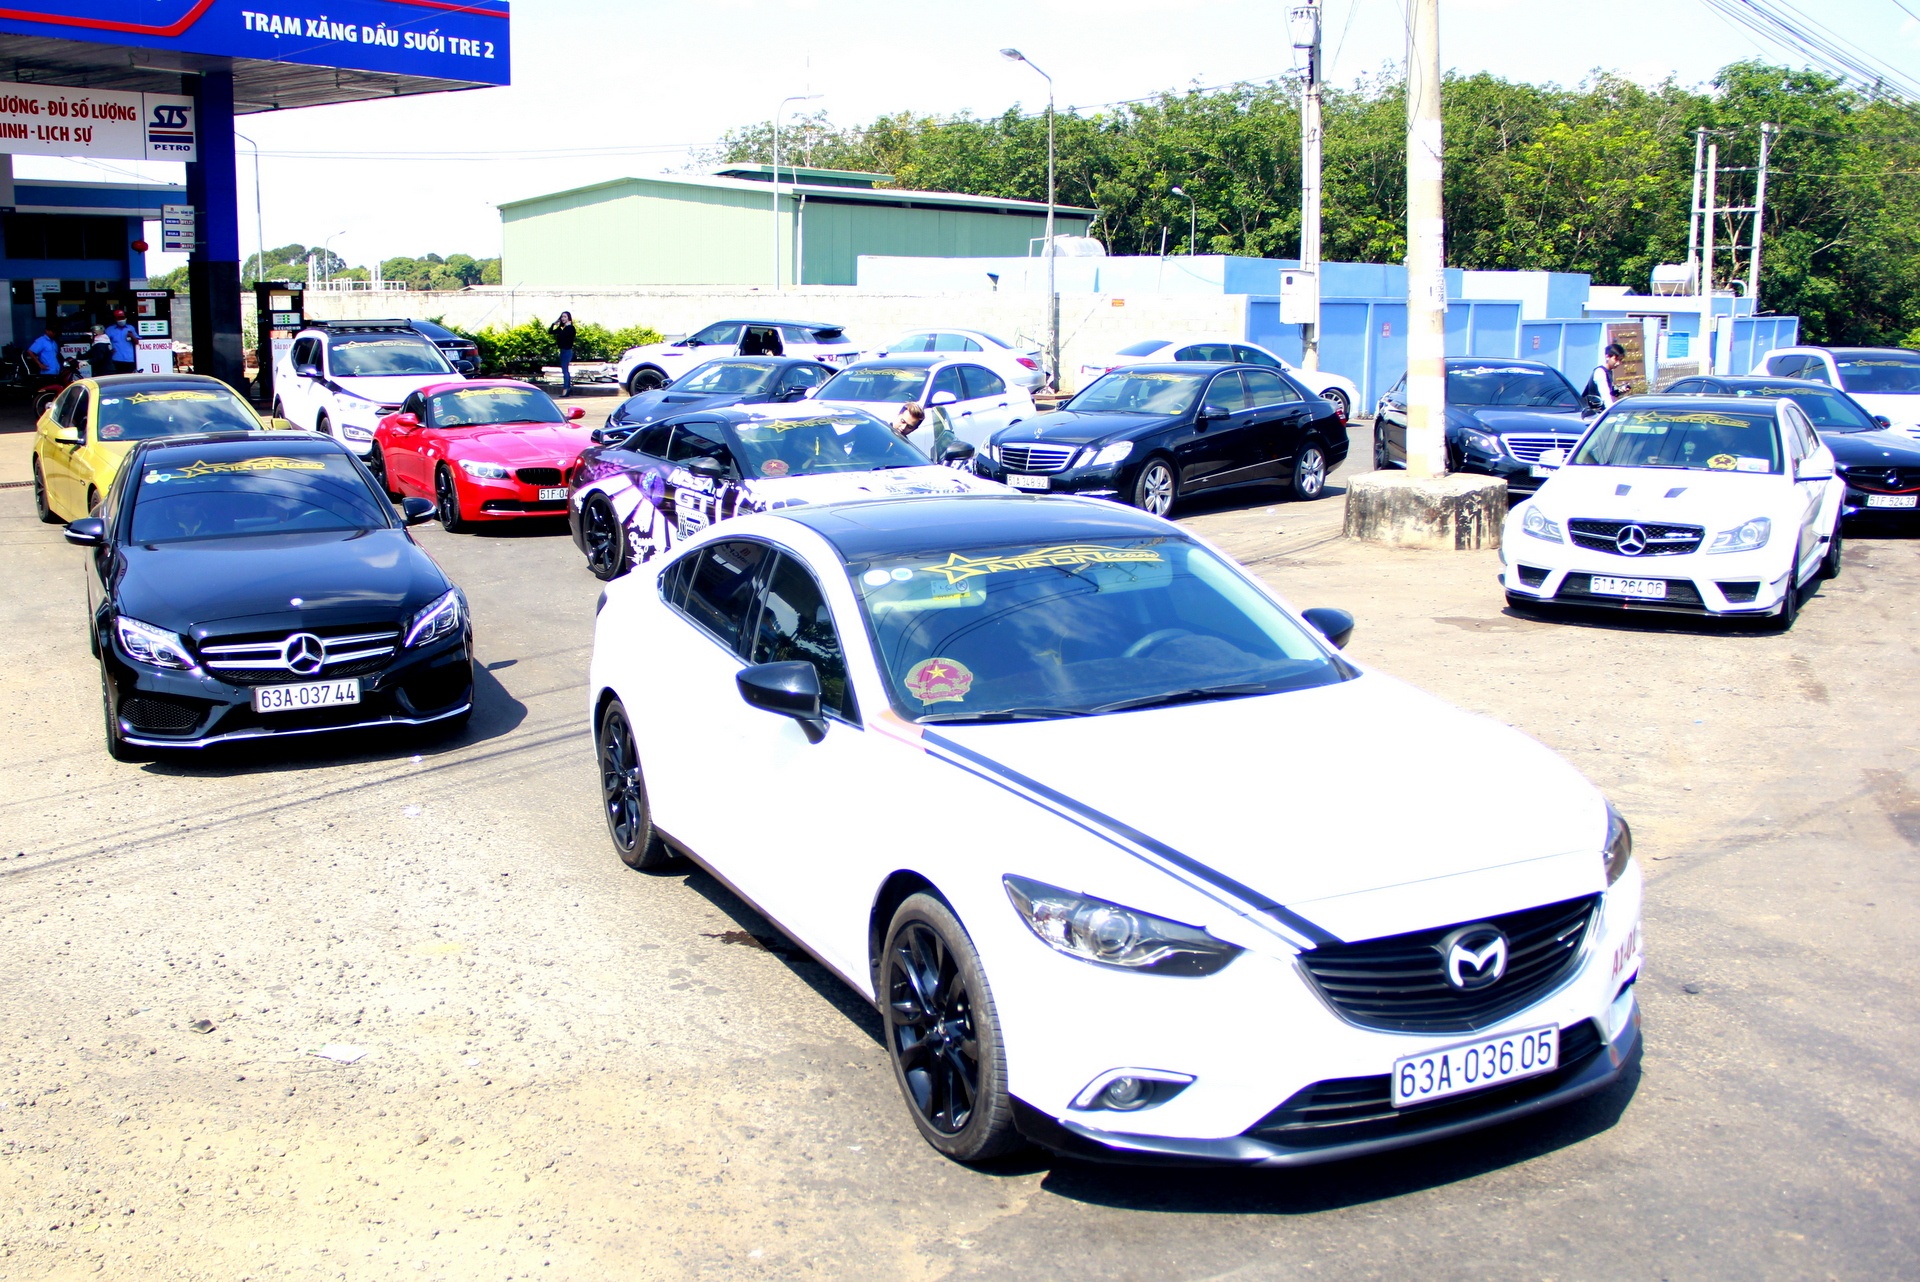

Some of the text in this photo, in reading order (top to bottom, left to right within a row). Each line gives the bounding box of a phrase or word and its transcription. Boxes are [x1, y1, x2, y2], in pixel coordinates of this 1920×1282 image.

[242, 11, 495, 58] TRẠM XĂNG DẦU SUỐI TRE 2
[47, 97, 68, 117] ĐỦ
[71, 97, 89, 118] SỐ
[92, 102, 137, 123] LƯỢNG
[0, 123, 28, 139] INH
[38, 125, 70, 144] LỊCH
[74, 125, 93, 146] SỰ
[154, 144, 191, 152] PETRO
[261, 683, 356, 708] 63A-037.44
[1400, 1029, 1552, 1098] 63A-036.05
